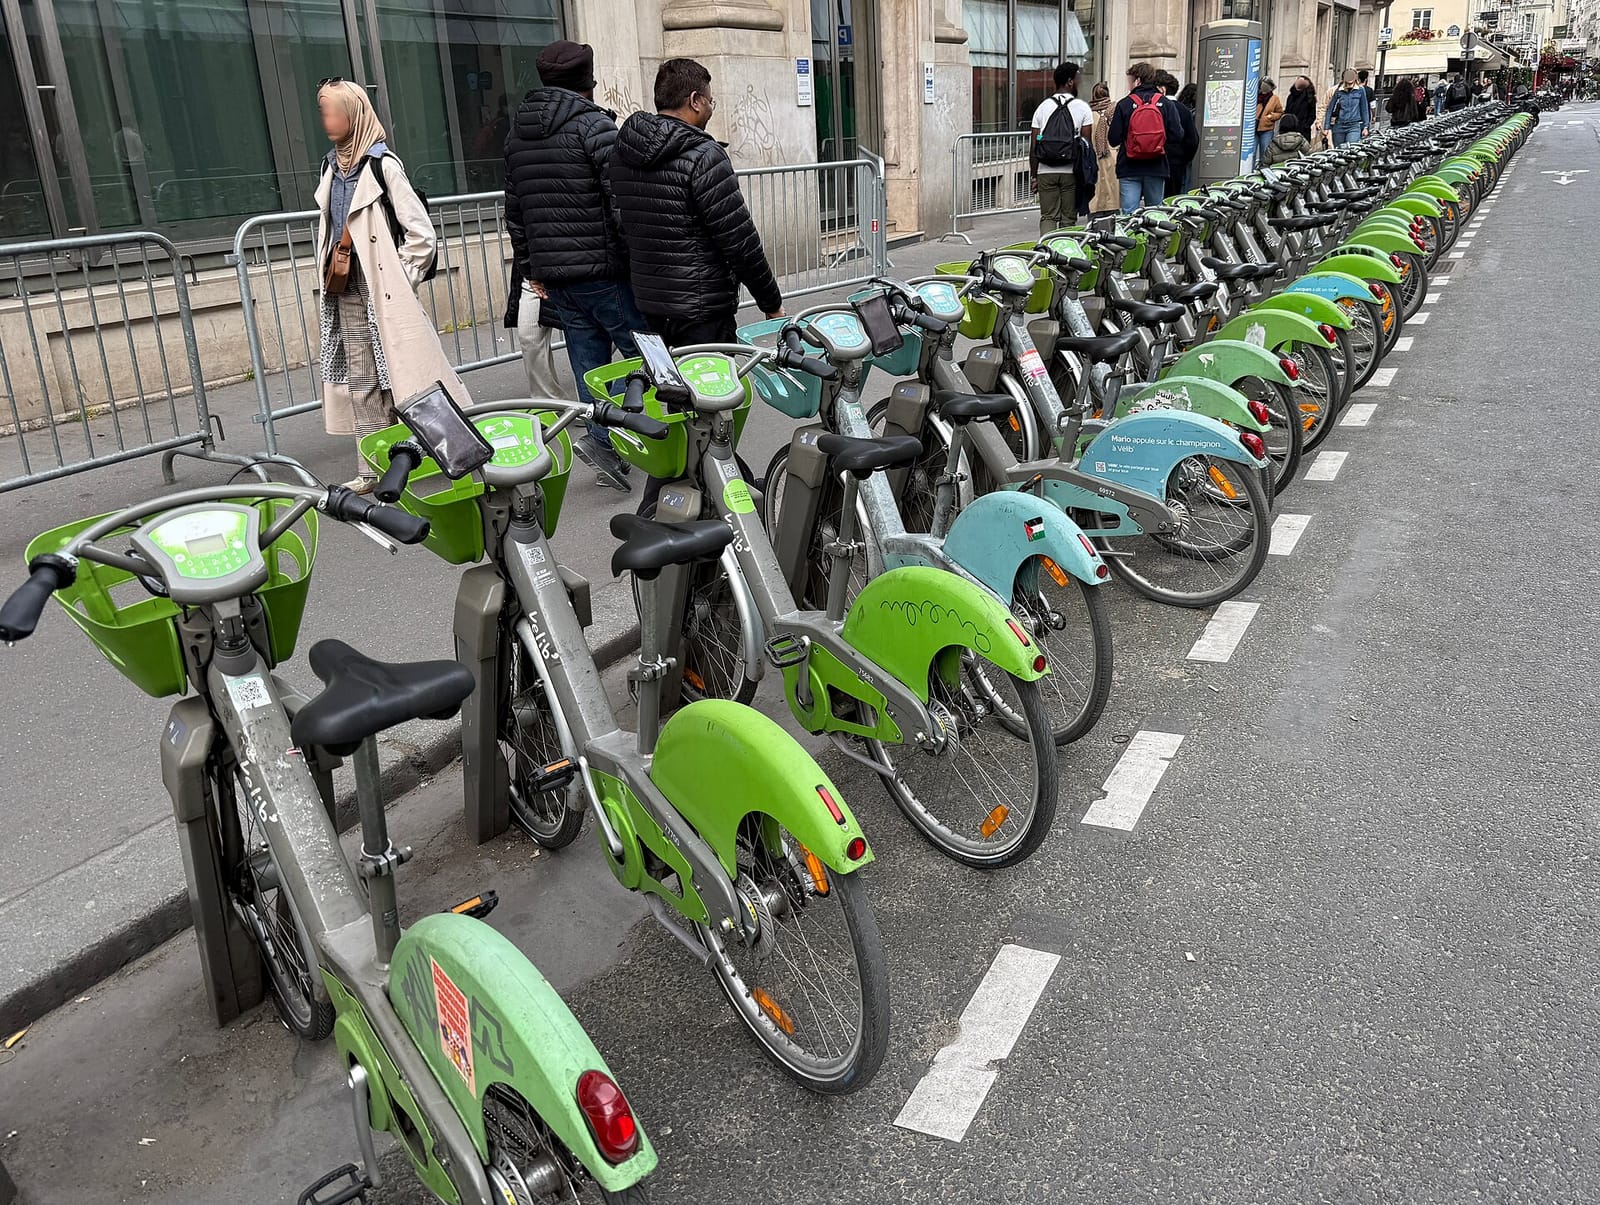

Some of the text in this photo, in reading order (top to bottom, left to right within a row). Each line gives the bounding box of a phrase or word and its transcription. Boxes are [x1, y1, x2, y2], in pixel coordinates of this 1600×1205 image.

[1111, 434, 1131, 443] Mario
[1168, 438, 1174, 446] le
[1175, 438, 1221, 449] champignon
